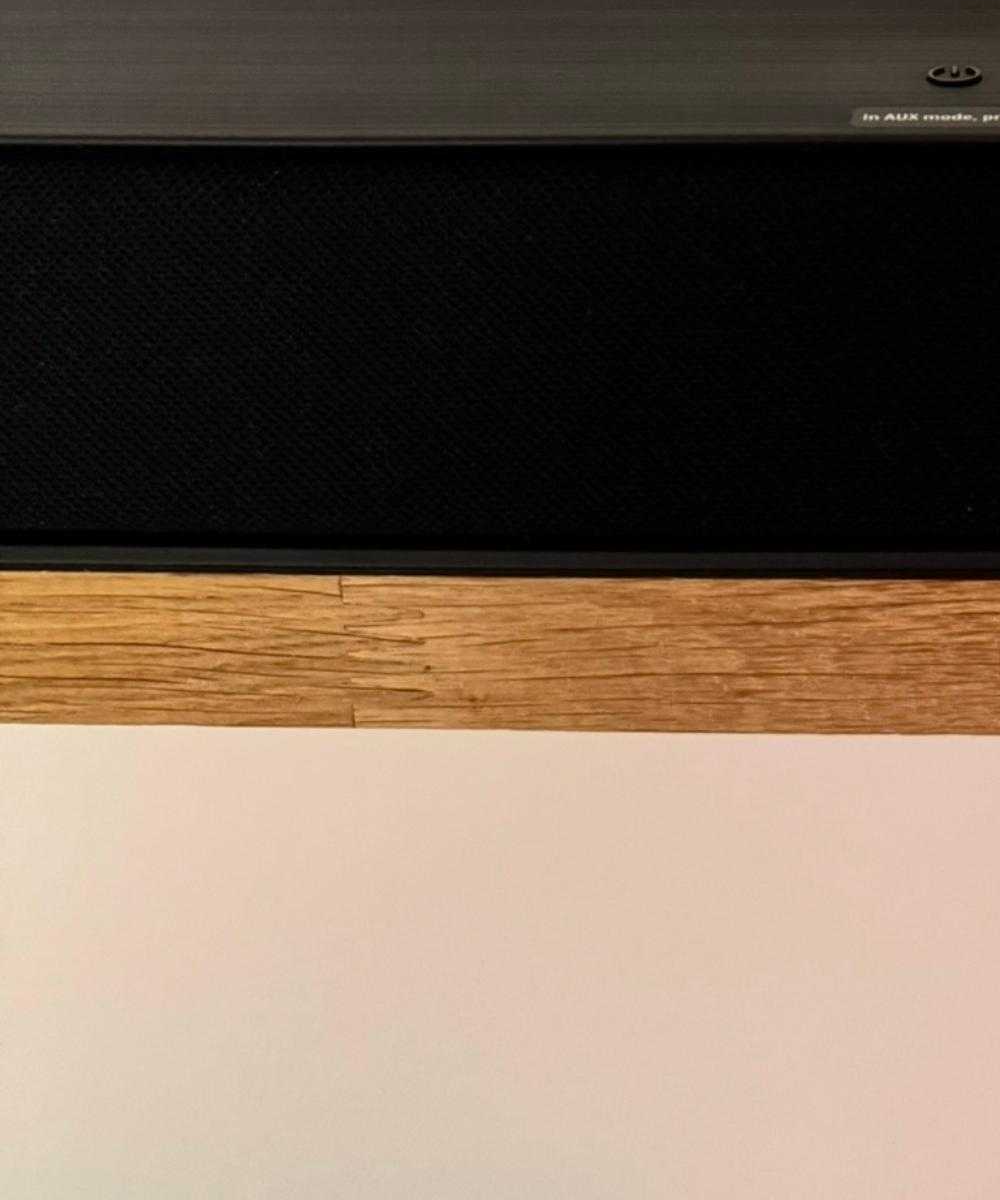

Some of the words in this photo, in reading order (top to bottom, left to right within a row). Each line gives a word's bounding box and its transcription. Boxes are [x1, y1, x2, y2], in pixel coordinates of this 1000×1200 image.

[861, 111, 881, 123] In
[882, 111, 920, 123] AUX
[922, 111, 979, 124] mode,
